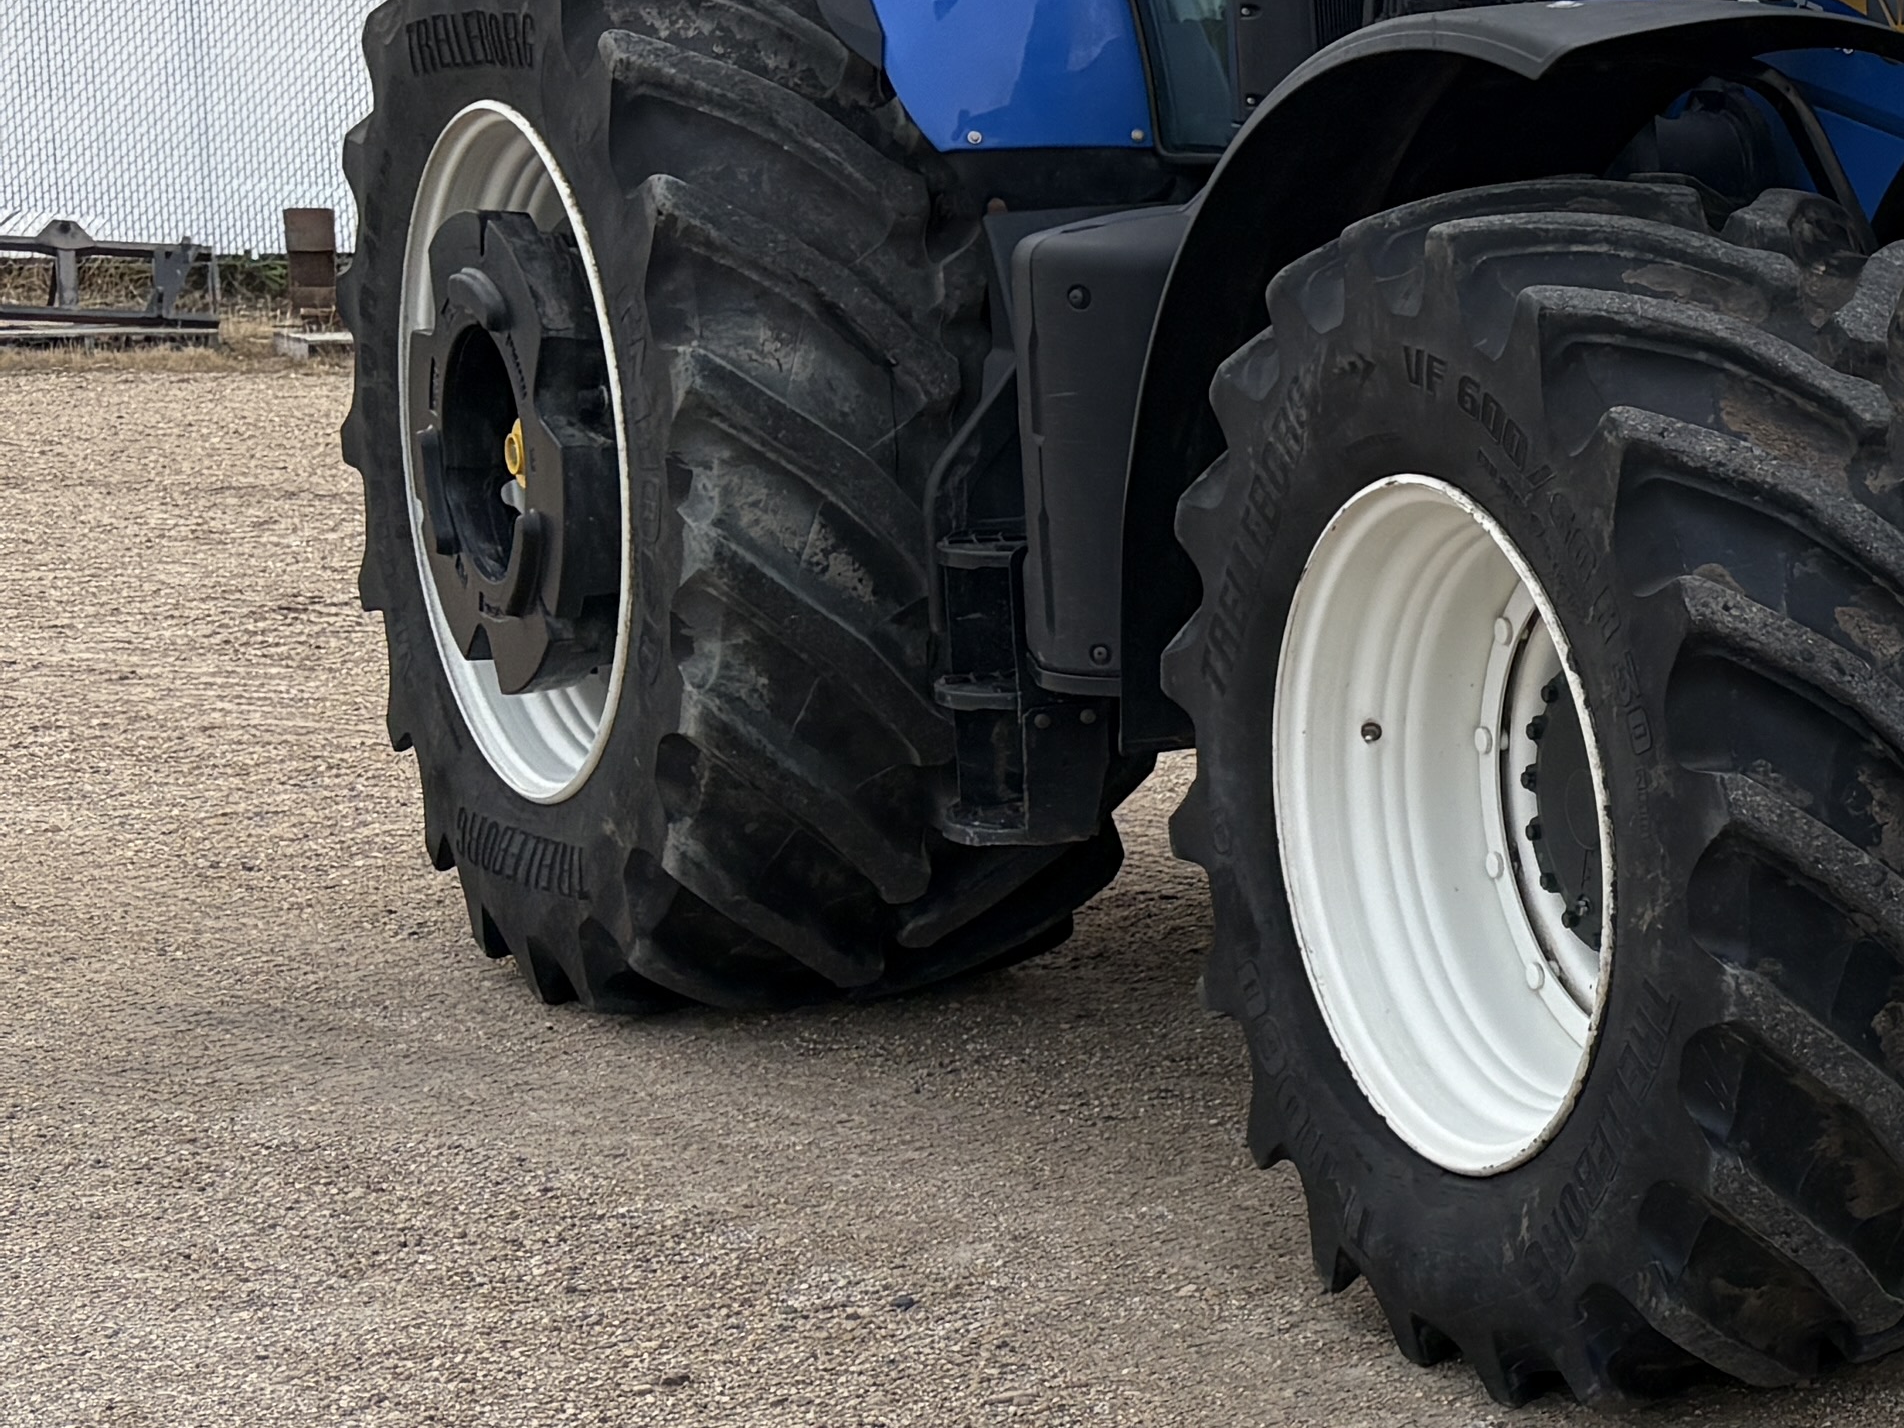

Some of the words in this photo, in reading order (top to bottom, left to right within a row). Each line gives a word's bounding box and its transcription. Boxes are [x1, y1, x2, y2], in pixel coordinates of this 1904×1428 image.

[405, 9, 536, 77] TRELLEBORG
[1403, 344, 1449, 395] VF
[1200, 373, 1311, 699] TRELLEBORG
[1527, 974, 1680, 1305] TRELLEBORG
